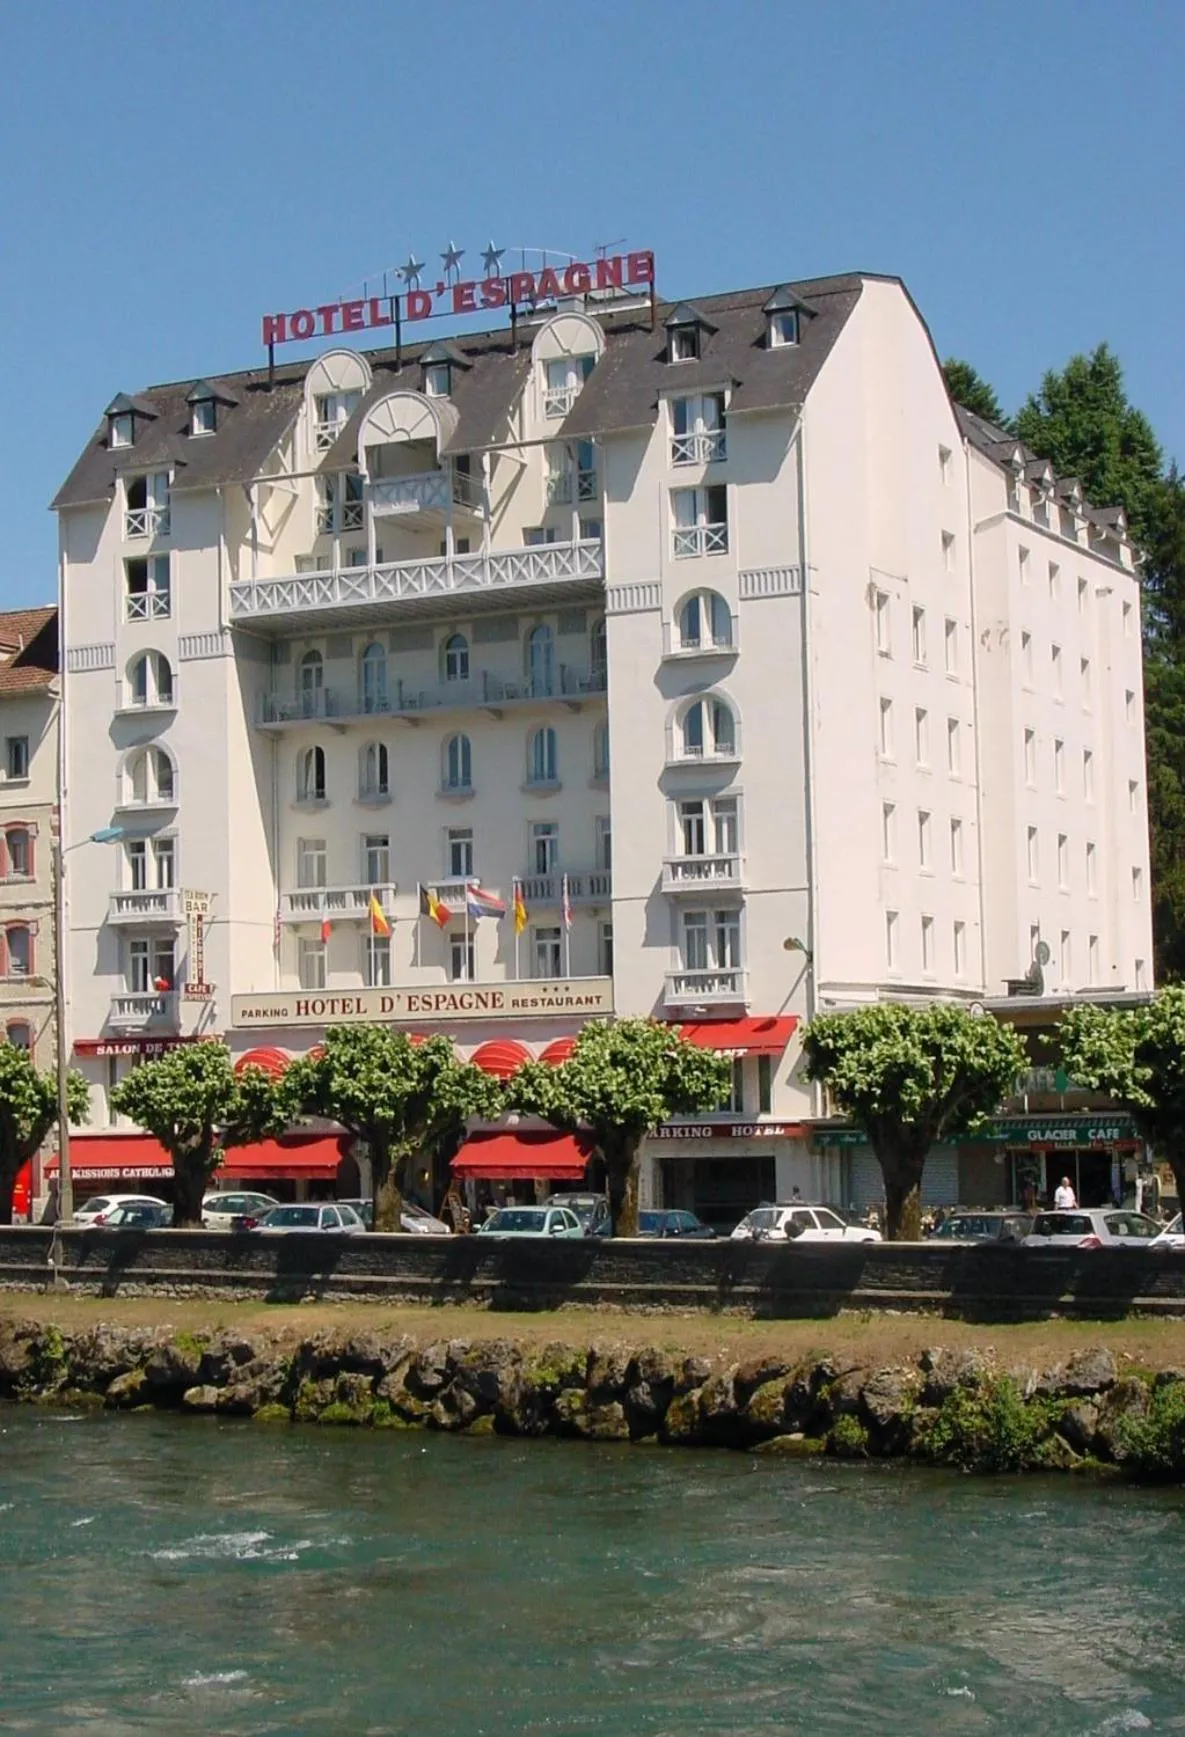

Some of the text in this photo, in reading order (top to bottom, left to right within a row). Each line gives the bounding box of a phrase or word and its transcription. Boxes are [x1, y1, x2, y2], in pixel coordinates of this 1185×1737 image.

[263, 250, 654, 345] HOTEL D'ESPAGNE
[186, 901, 208, 912] BAR
[241, 990, 603, 1018] PARKING HOTEL D'ESPAGNE RESTAURANT
[96, 1044, 140, 1056] SALON
[145, 1043, 163, 1054] DE
[647, 1125, 785, 1138] ARKING HOTEL
[1027, 1130, 1077, 1141] GLACIER
[1087, 1128, 1120, 1139] CAFE
[72, 1168, 119, 1179] MISSIONS
